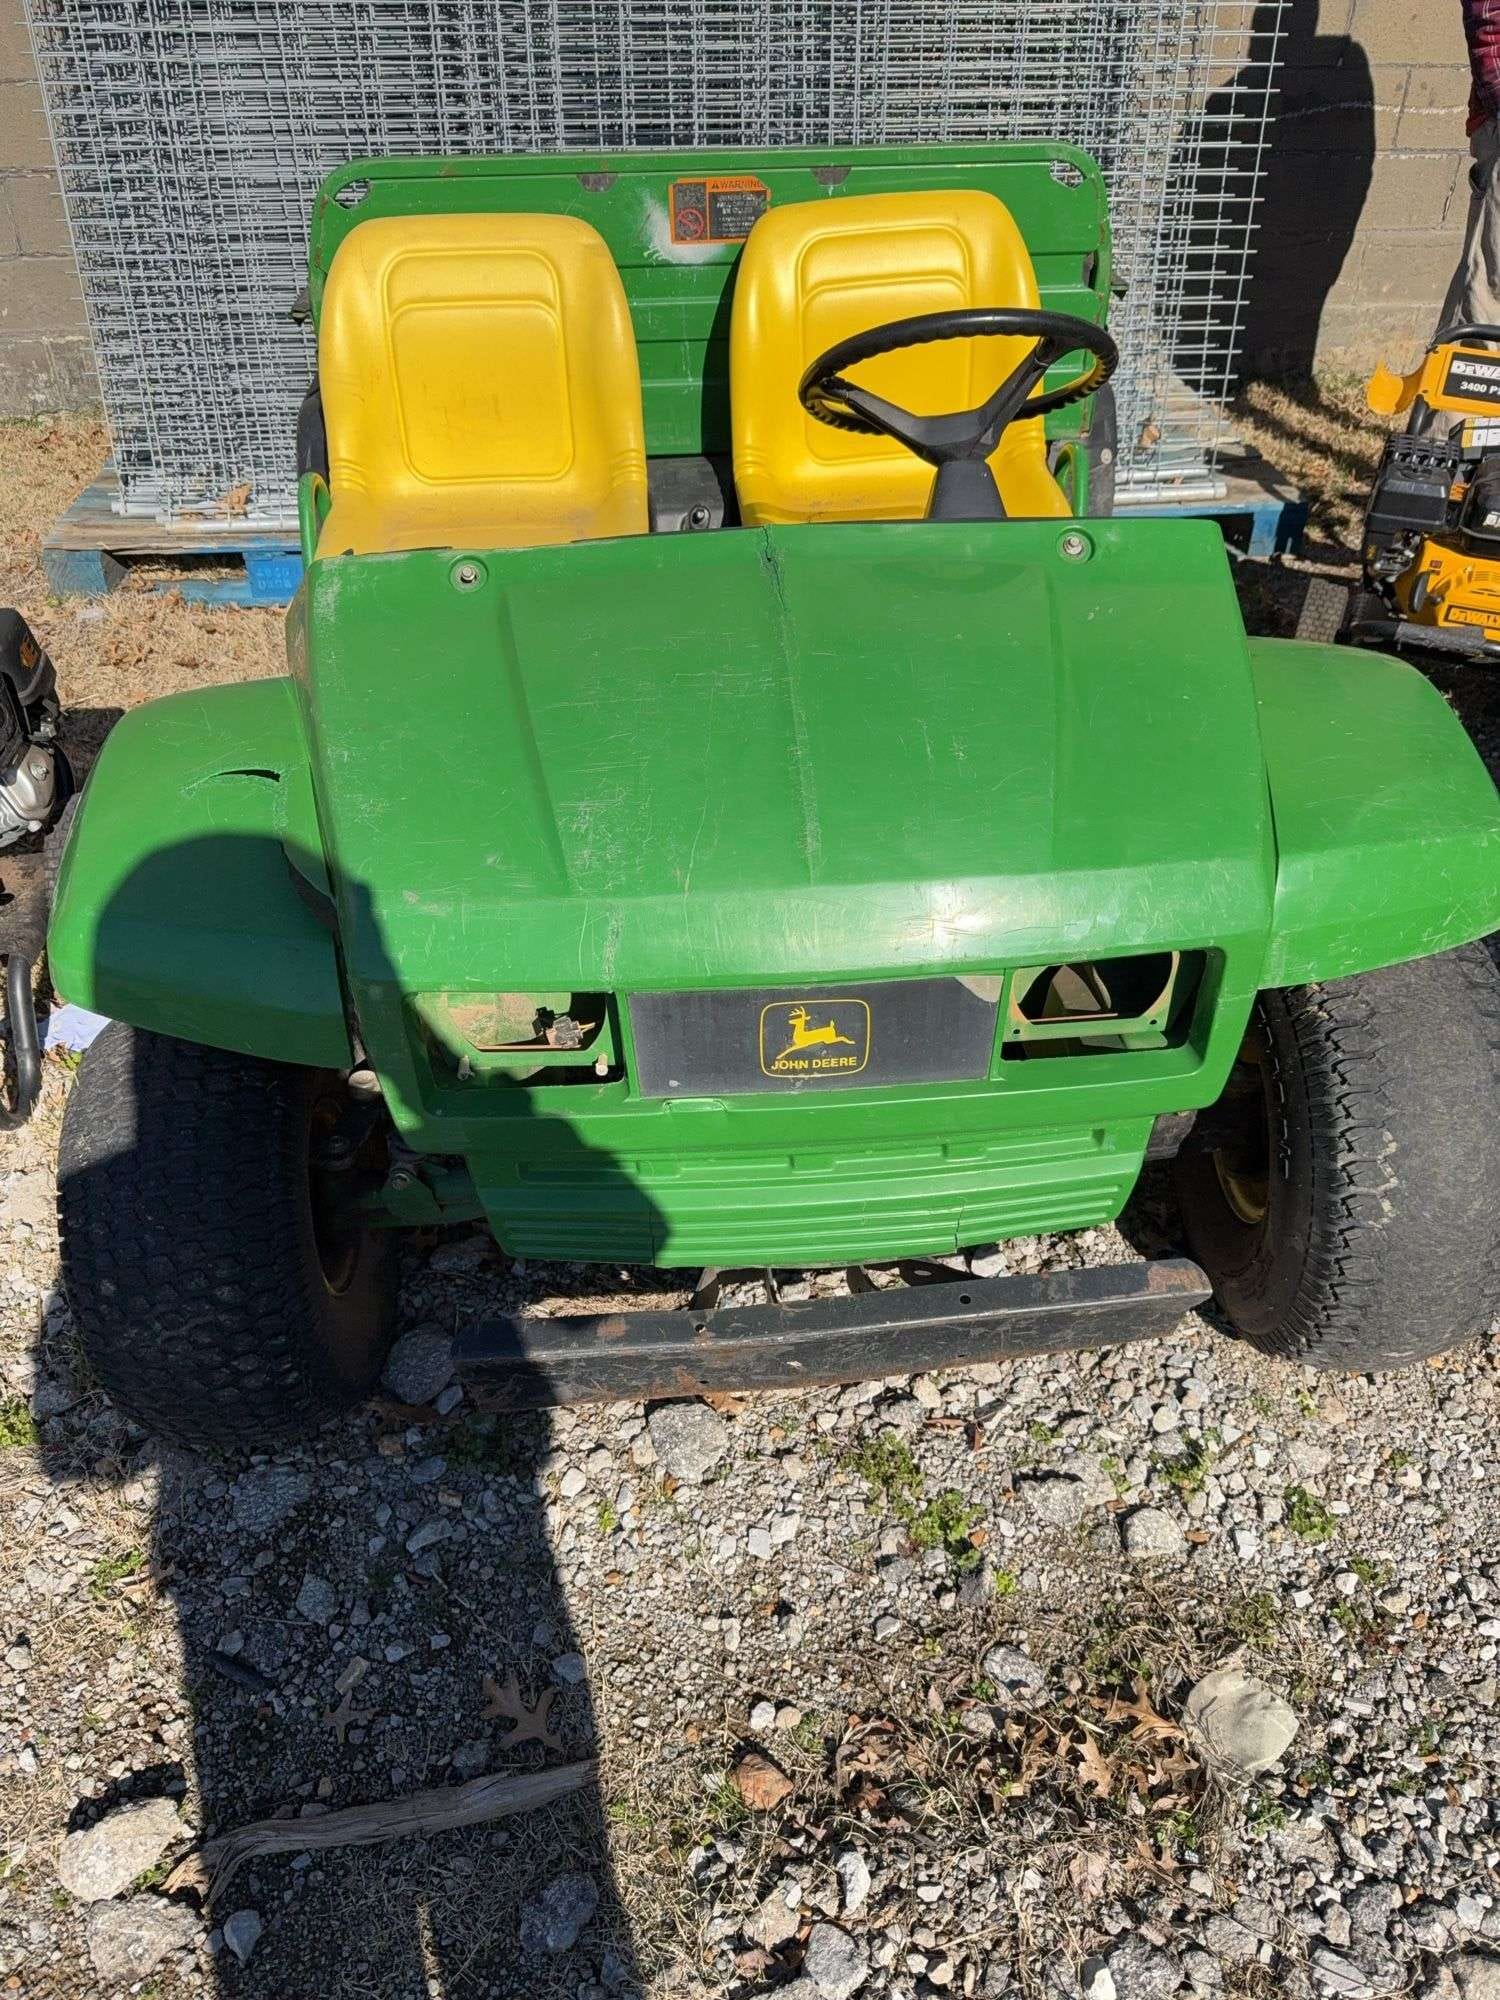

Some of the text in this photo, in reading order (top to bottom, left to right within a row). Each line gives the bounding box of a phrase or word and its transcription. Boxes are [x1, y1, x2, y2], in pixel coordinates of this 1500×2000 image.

[1460, 381, 1488, 393] 3400
[771, 1057, 857, 1070] JOHN DEERE
